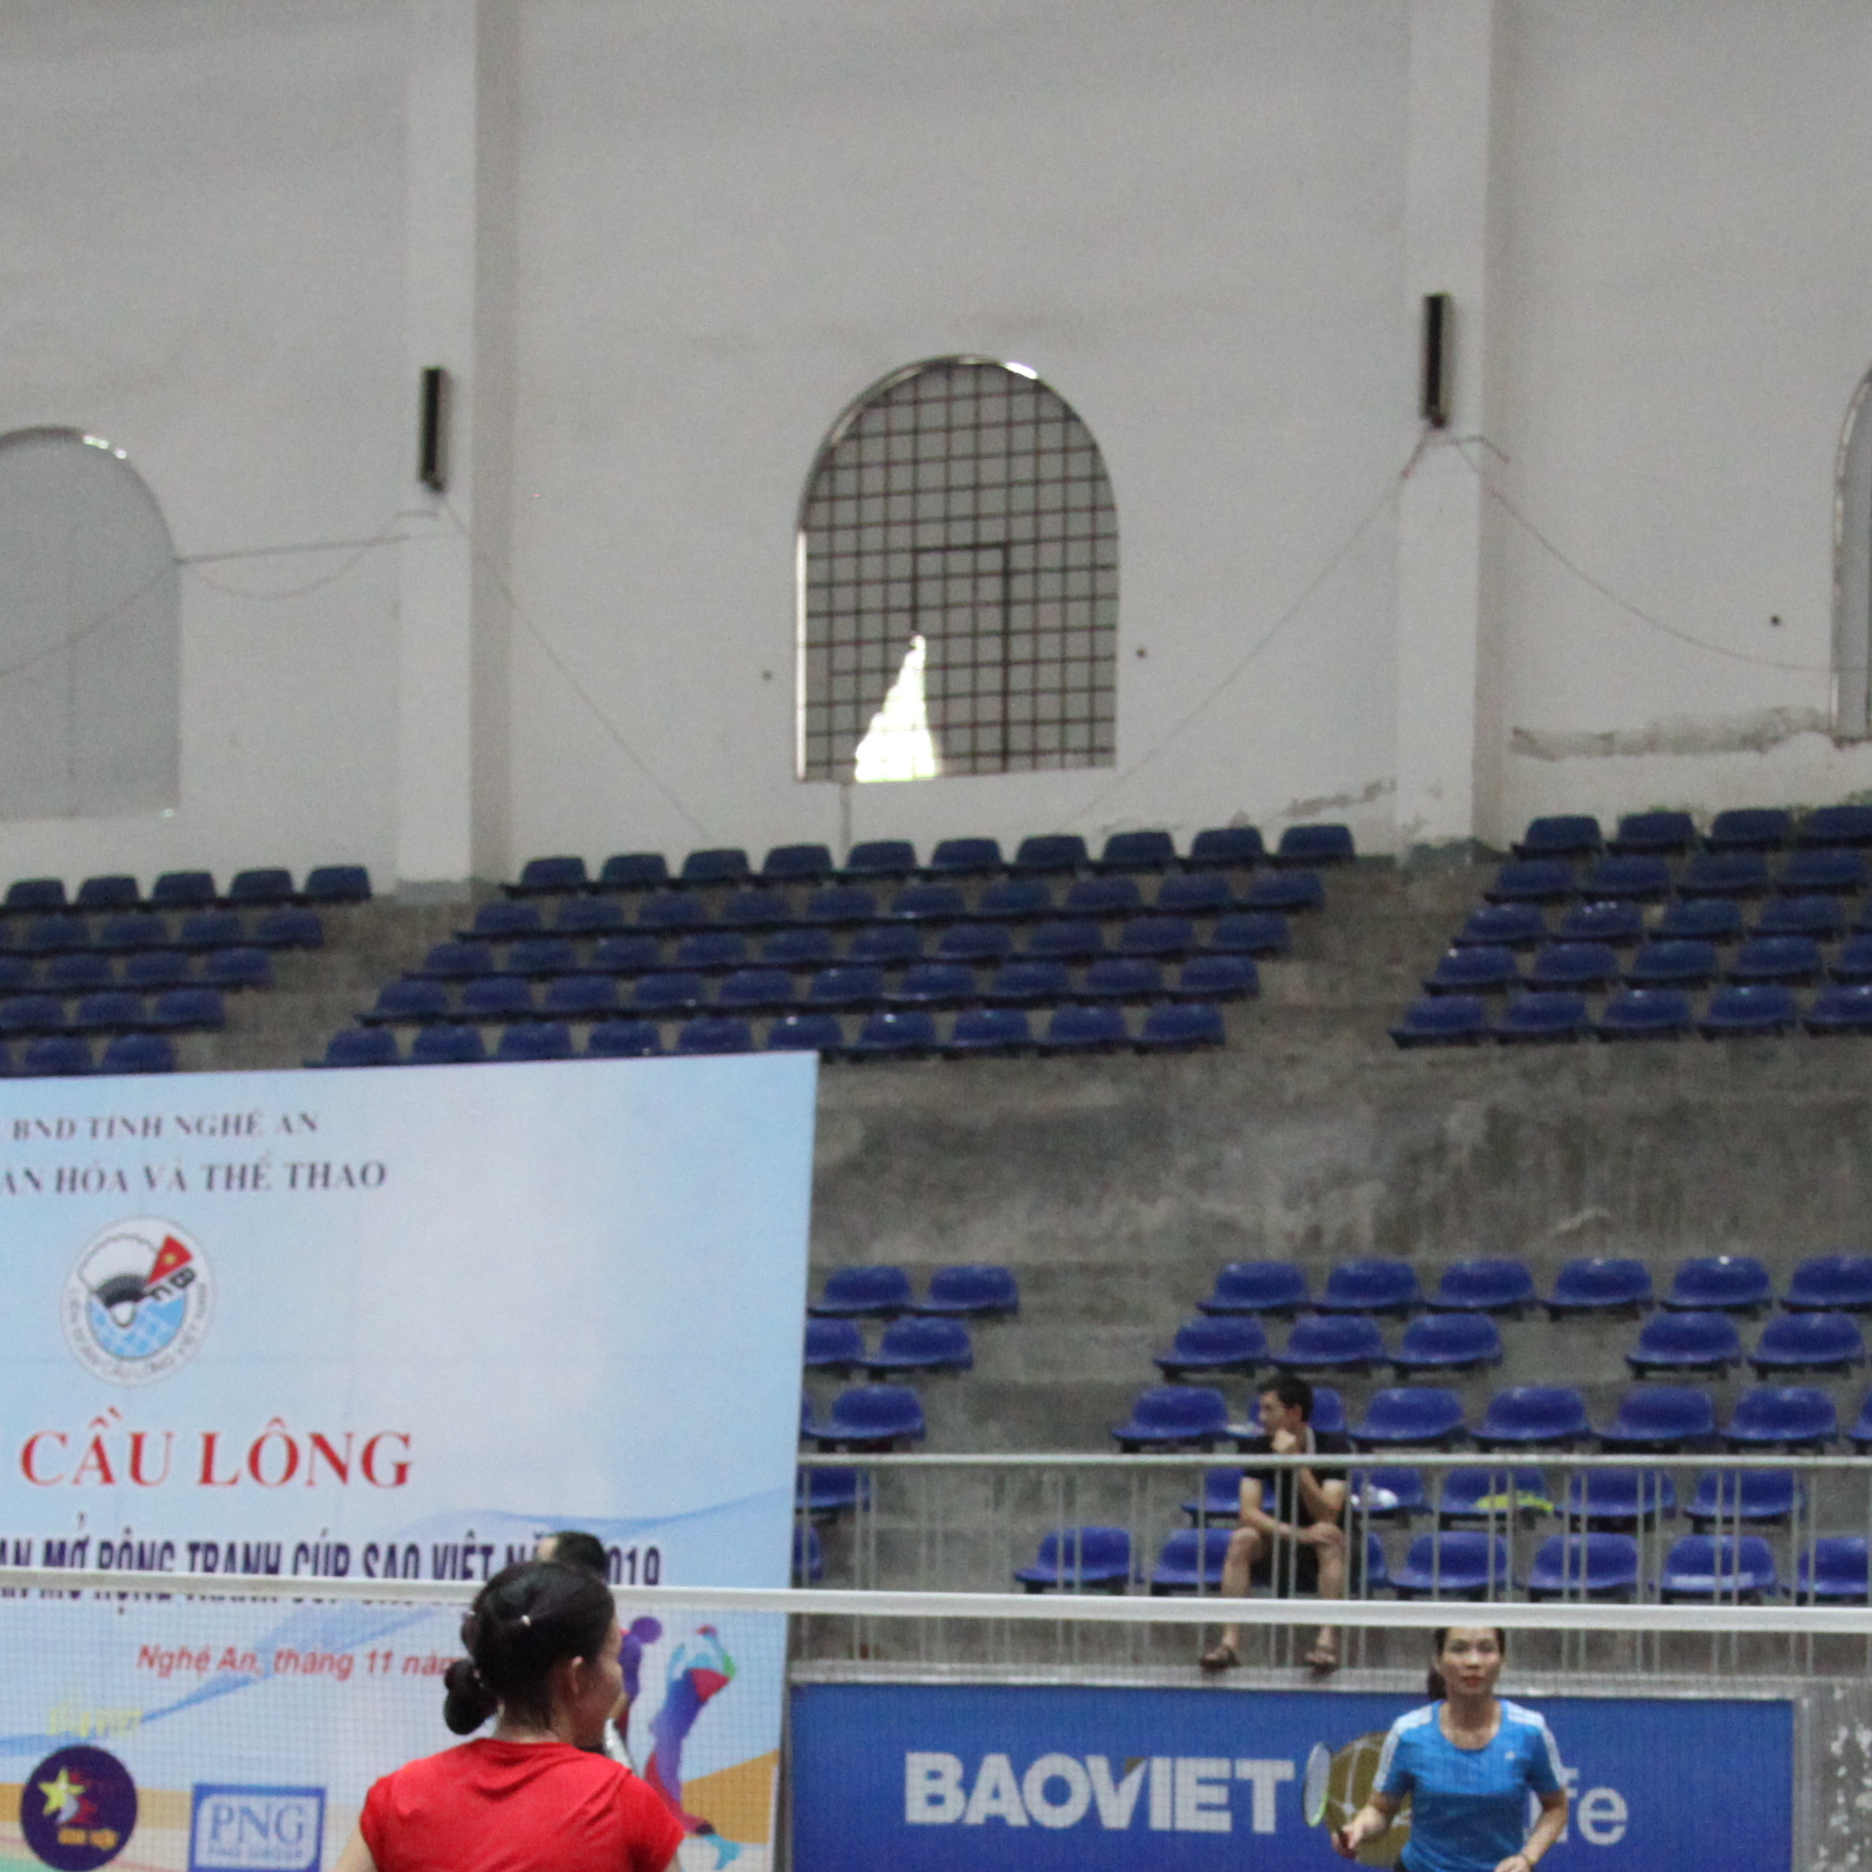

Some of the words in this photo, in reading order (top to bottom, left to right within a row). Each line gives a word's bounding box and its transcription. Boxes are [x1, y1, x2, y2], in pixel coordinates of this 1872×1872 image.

[275, 1111, 320, 1135] AN
[284, 1159, 388, 1190] THAO
[19, 1405, 174, 1488] CẦU
[195, 1416, 413, 1489] LÔNG
[366, 1650, 394, 1674] 11
[904, 1751, 1296, 1834] BAOVIET
[210, 1801, 305, 1845] PNG
